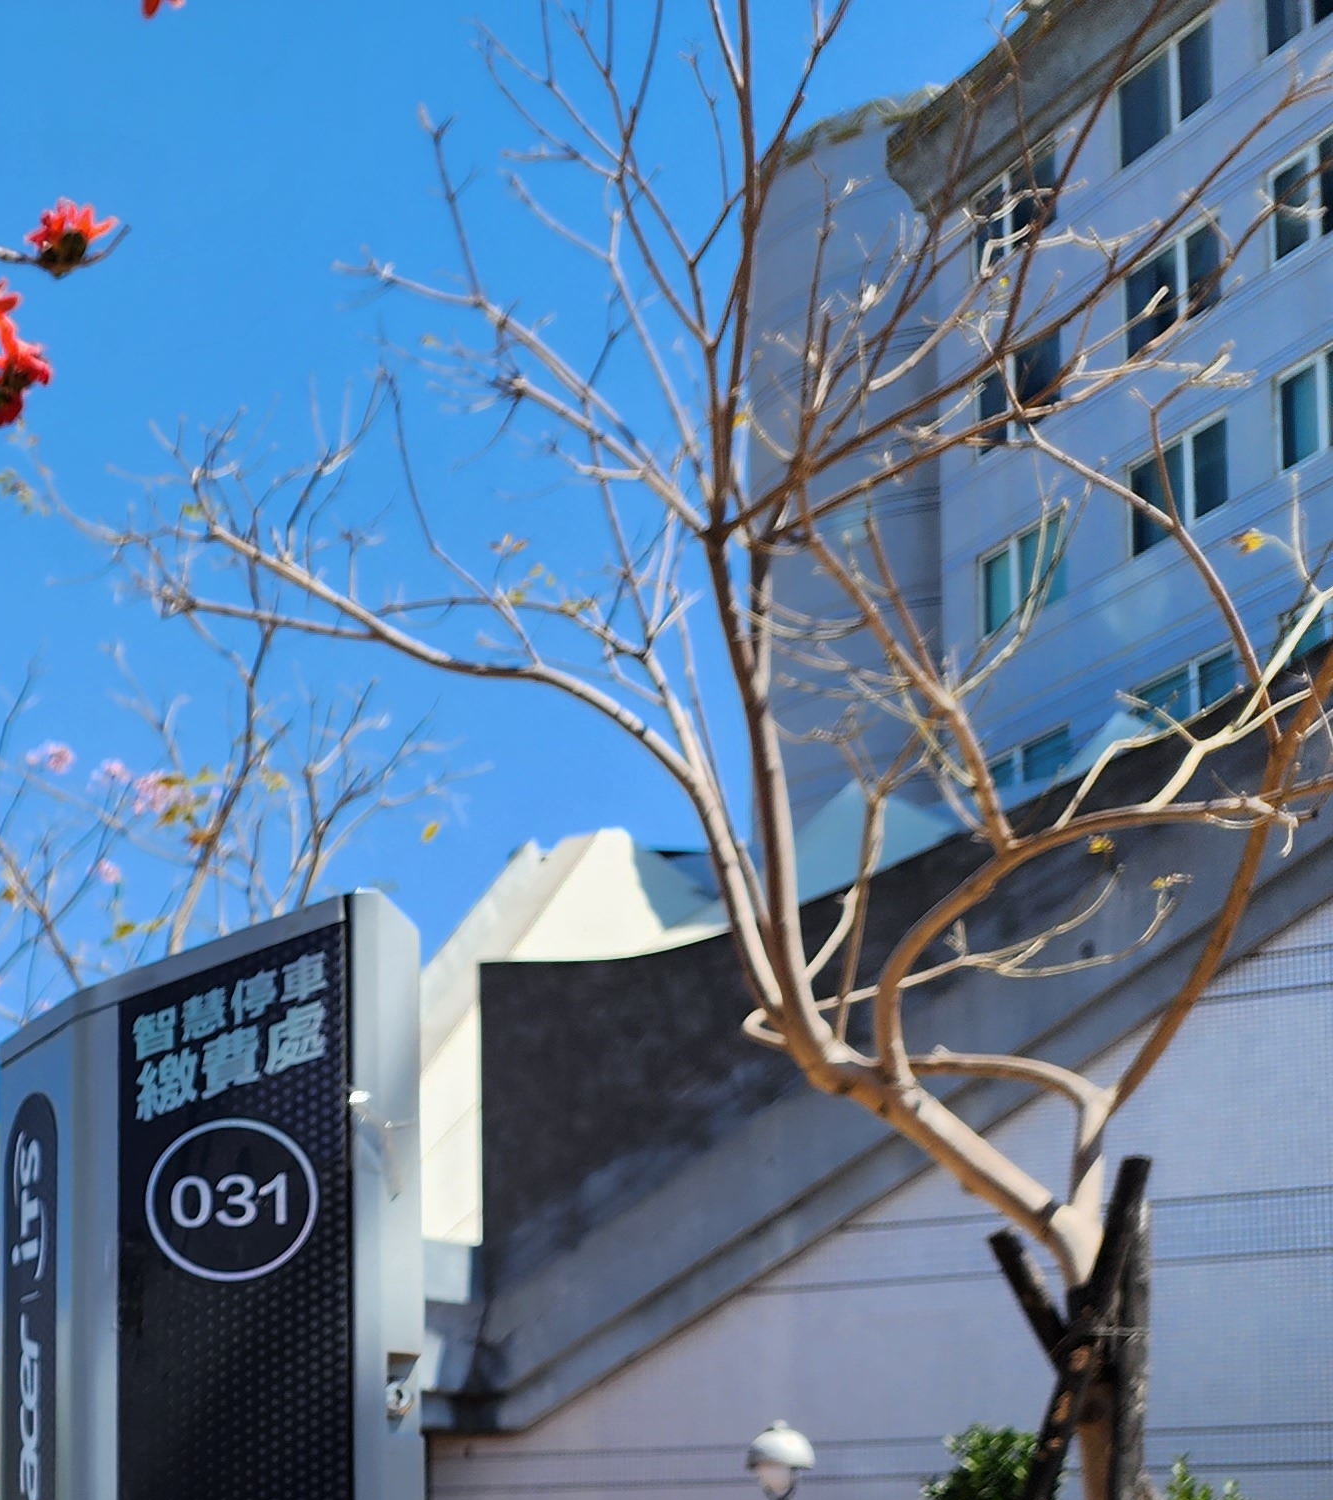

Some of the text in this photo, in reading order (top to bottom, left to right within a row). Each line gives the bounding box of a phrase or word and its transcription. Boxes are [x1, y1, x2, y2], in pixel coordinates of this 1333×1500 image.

[132, 950, 328, 1061] 智慧停車
[135, 1000, 327, 1122] 繳費處
[170, 1171, 289, 1229] 031
